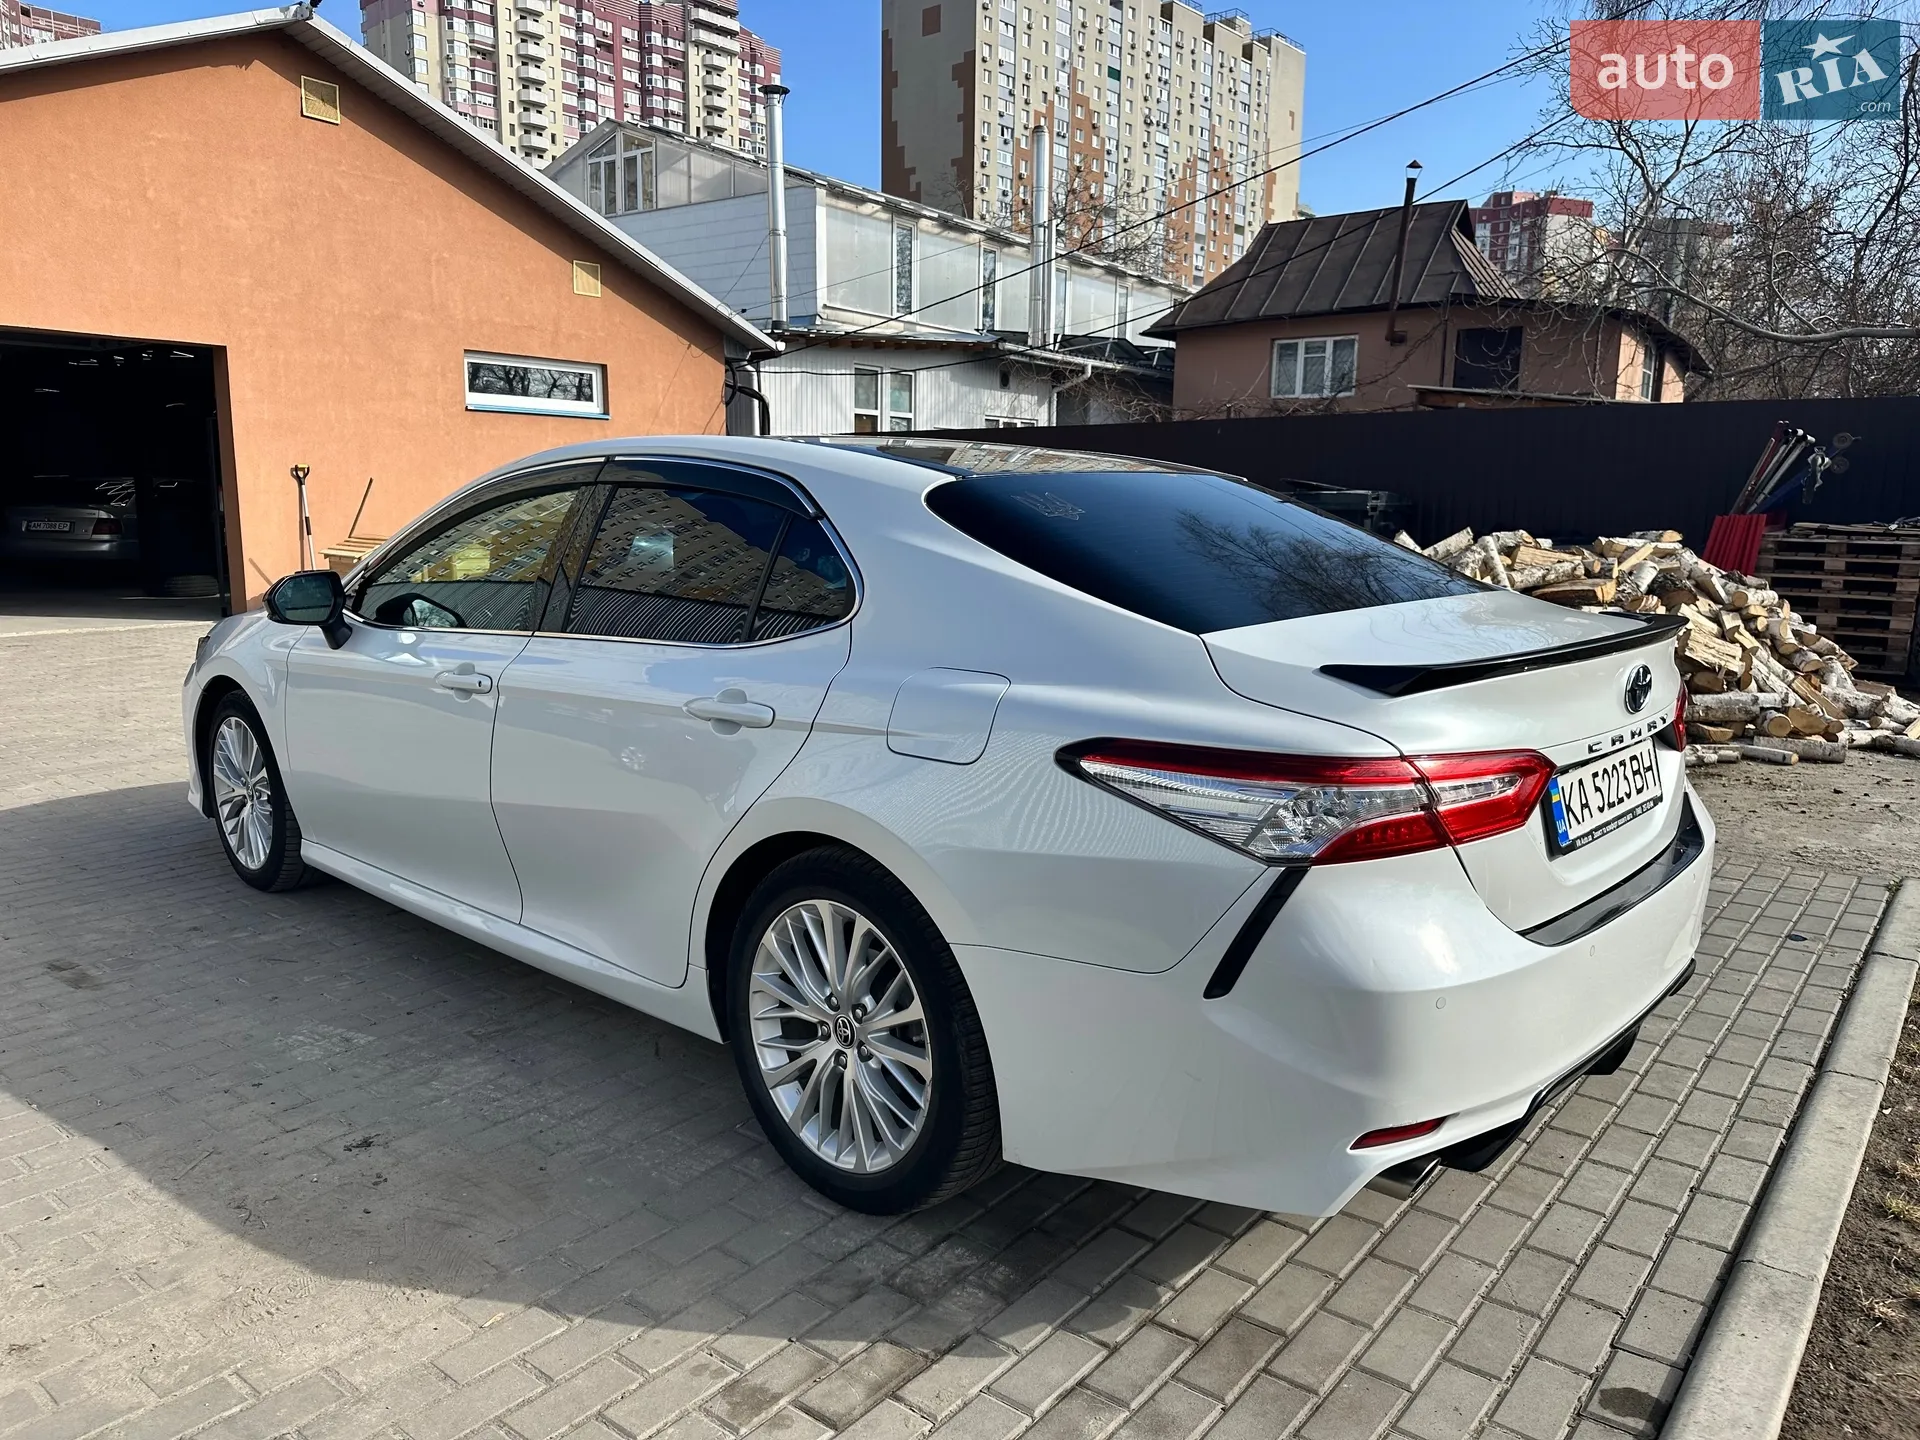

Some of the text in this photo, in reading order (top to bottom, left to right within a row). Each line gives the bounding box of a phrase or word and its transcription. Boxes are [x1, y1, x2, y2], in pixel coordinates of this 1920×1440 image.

[1587, 714, 1668, 754] CAMRY
[1561, 748, 1657, 830] KA 5223 BH
[1556, 819, 1567, 834] UA
